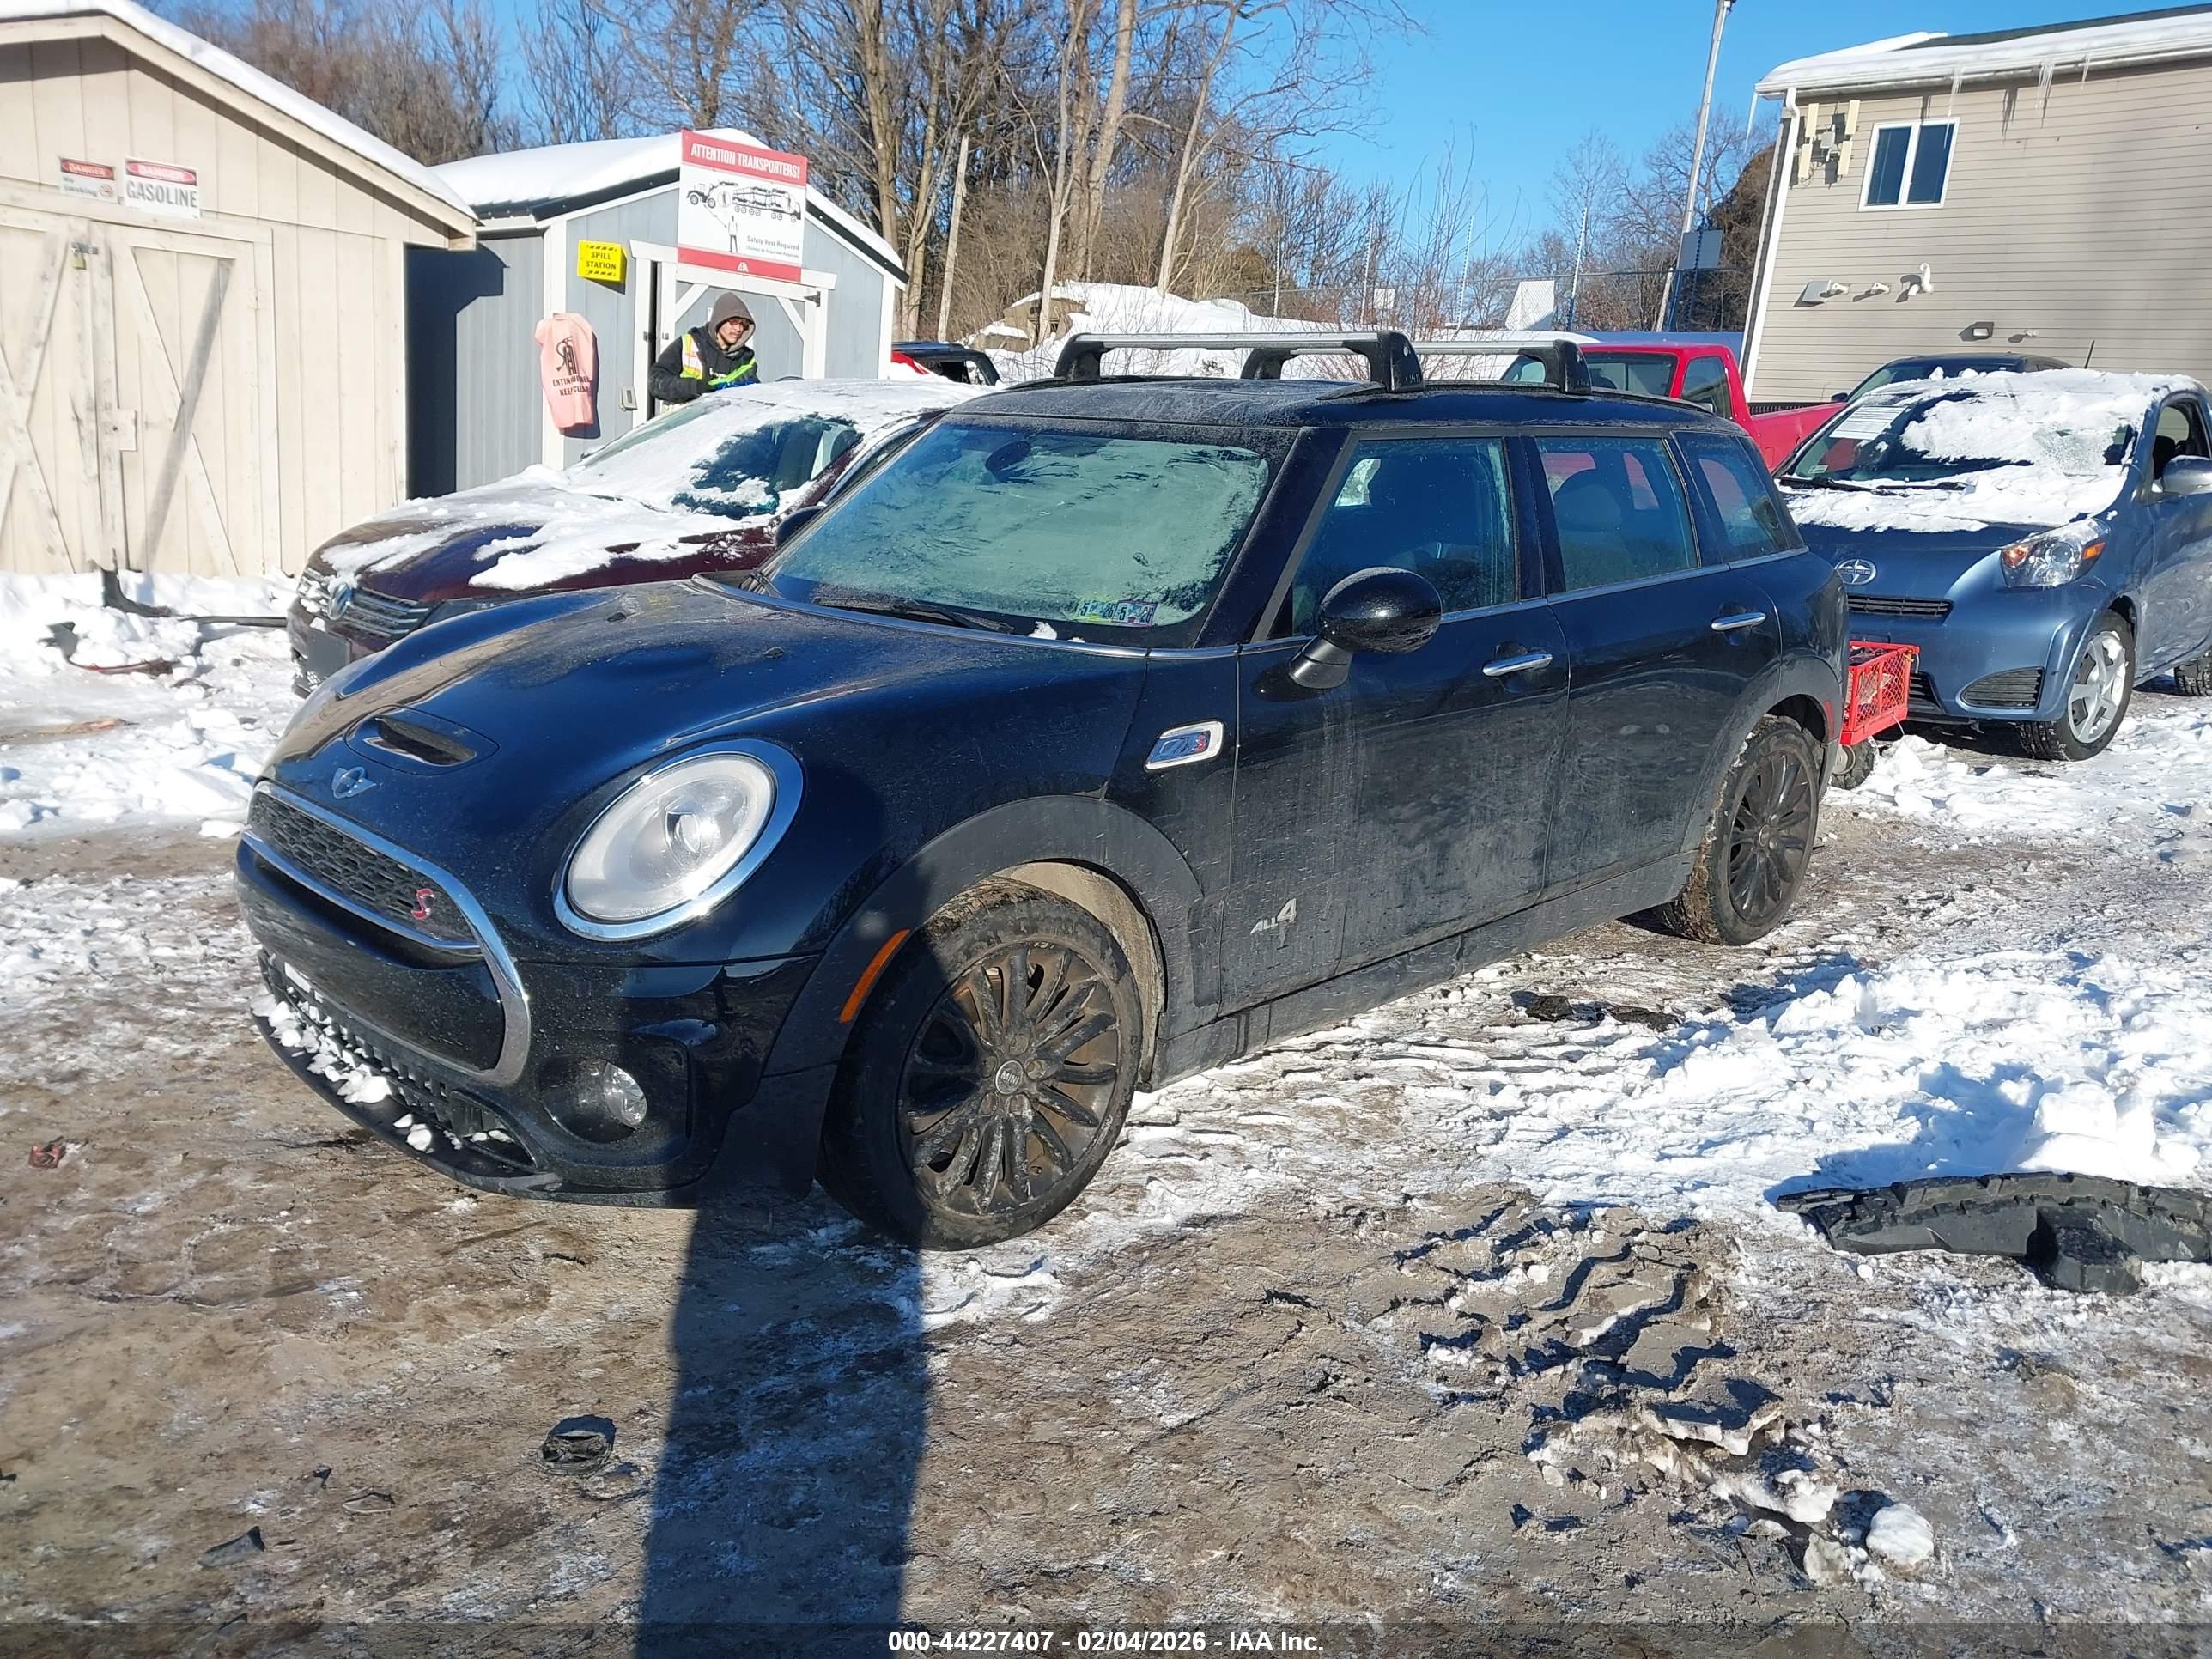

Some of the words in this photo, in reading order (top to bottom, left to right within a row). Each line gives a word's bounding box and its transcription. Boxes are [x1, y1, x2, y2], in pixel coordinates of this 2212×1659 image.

[690, 143, 737, 166] ATTENTION
[738, 152, 800, 179] TRANSPORTERS!
[127, 179, 198, 208] GASOLINE
[747, 234, 763, 246] Safety
[764, 238, 775, 246] Vest
[776, 240, 799, 251] Required
[591, 251, 611, 260] SPILL
[586, 260, 617, 270] STATION
[1000, 1070, 1019, 1086] MINI
